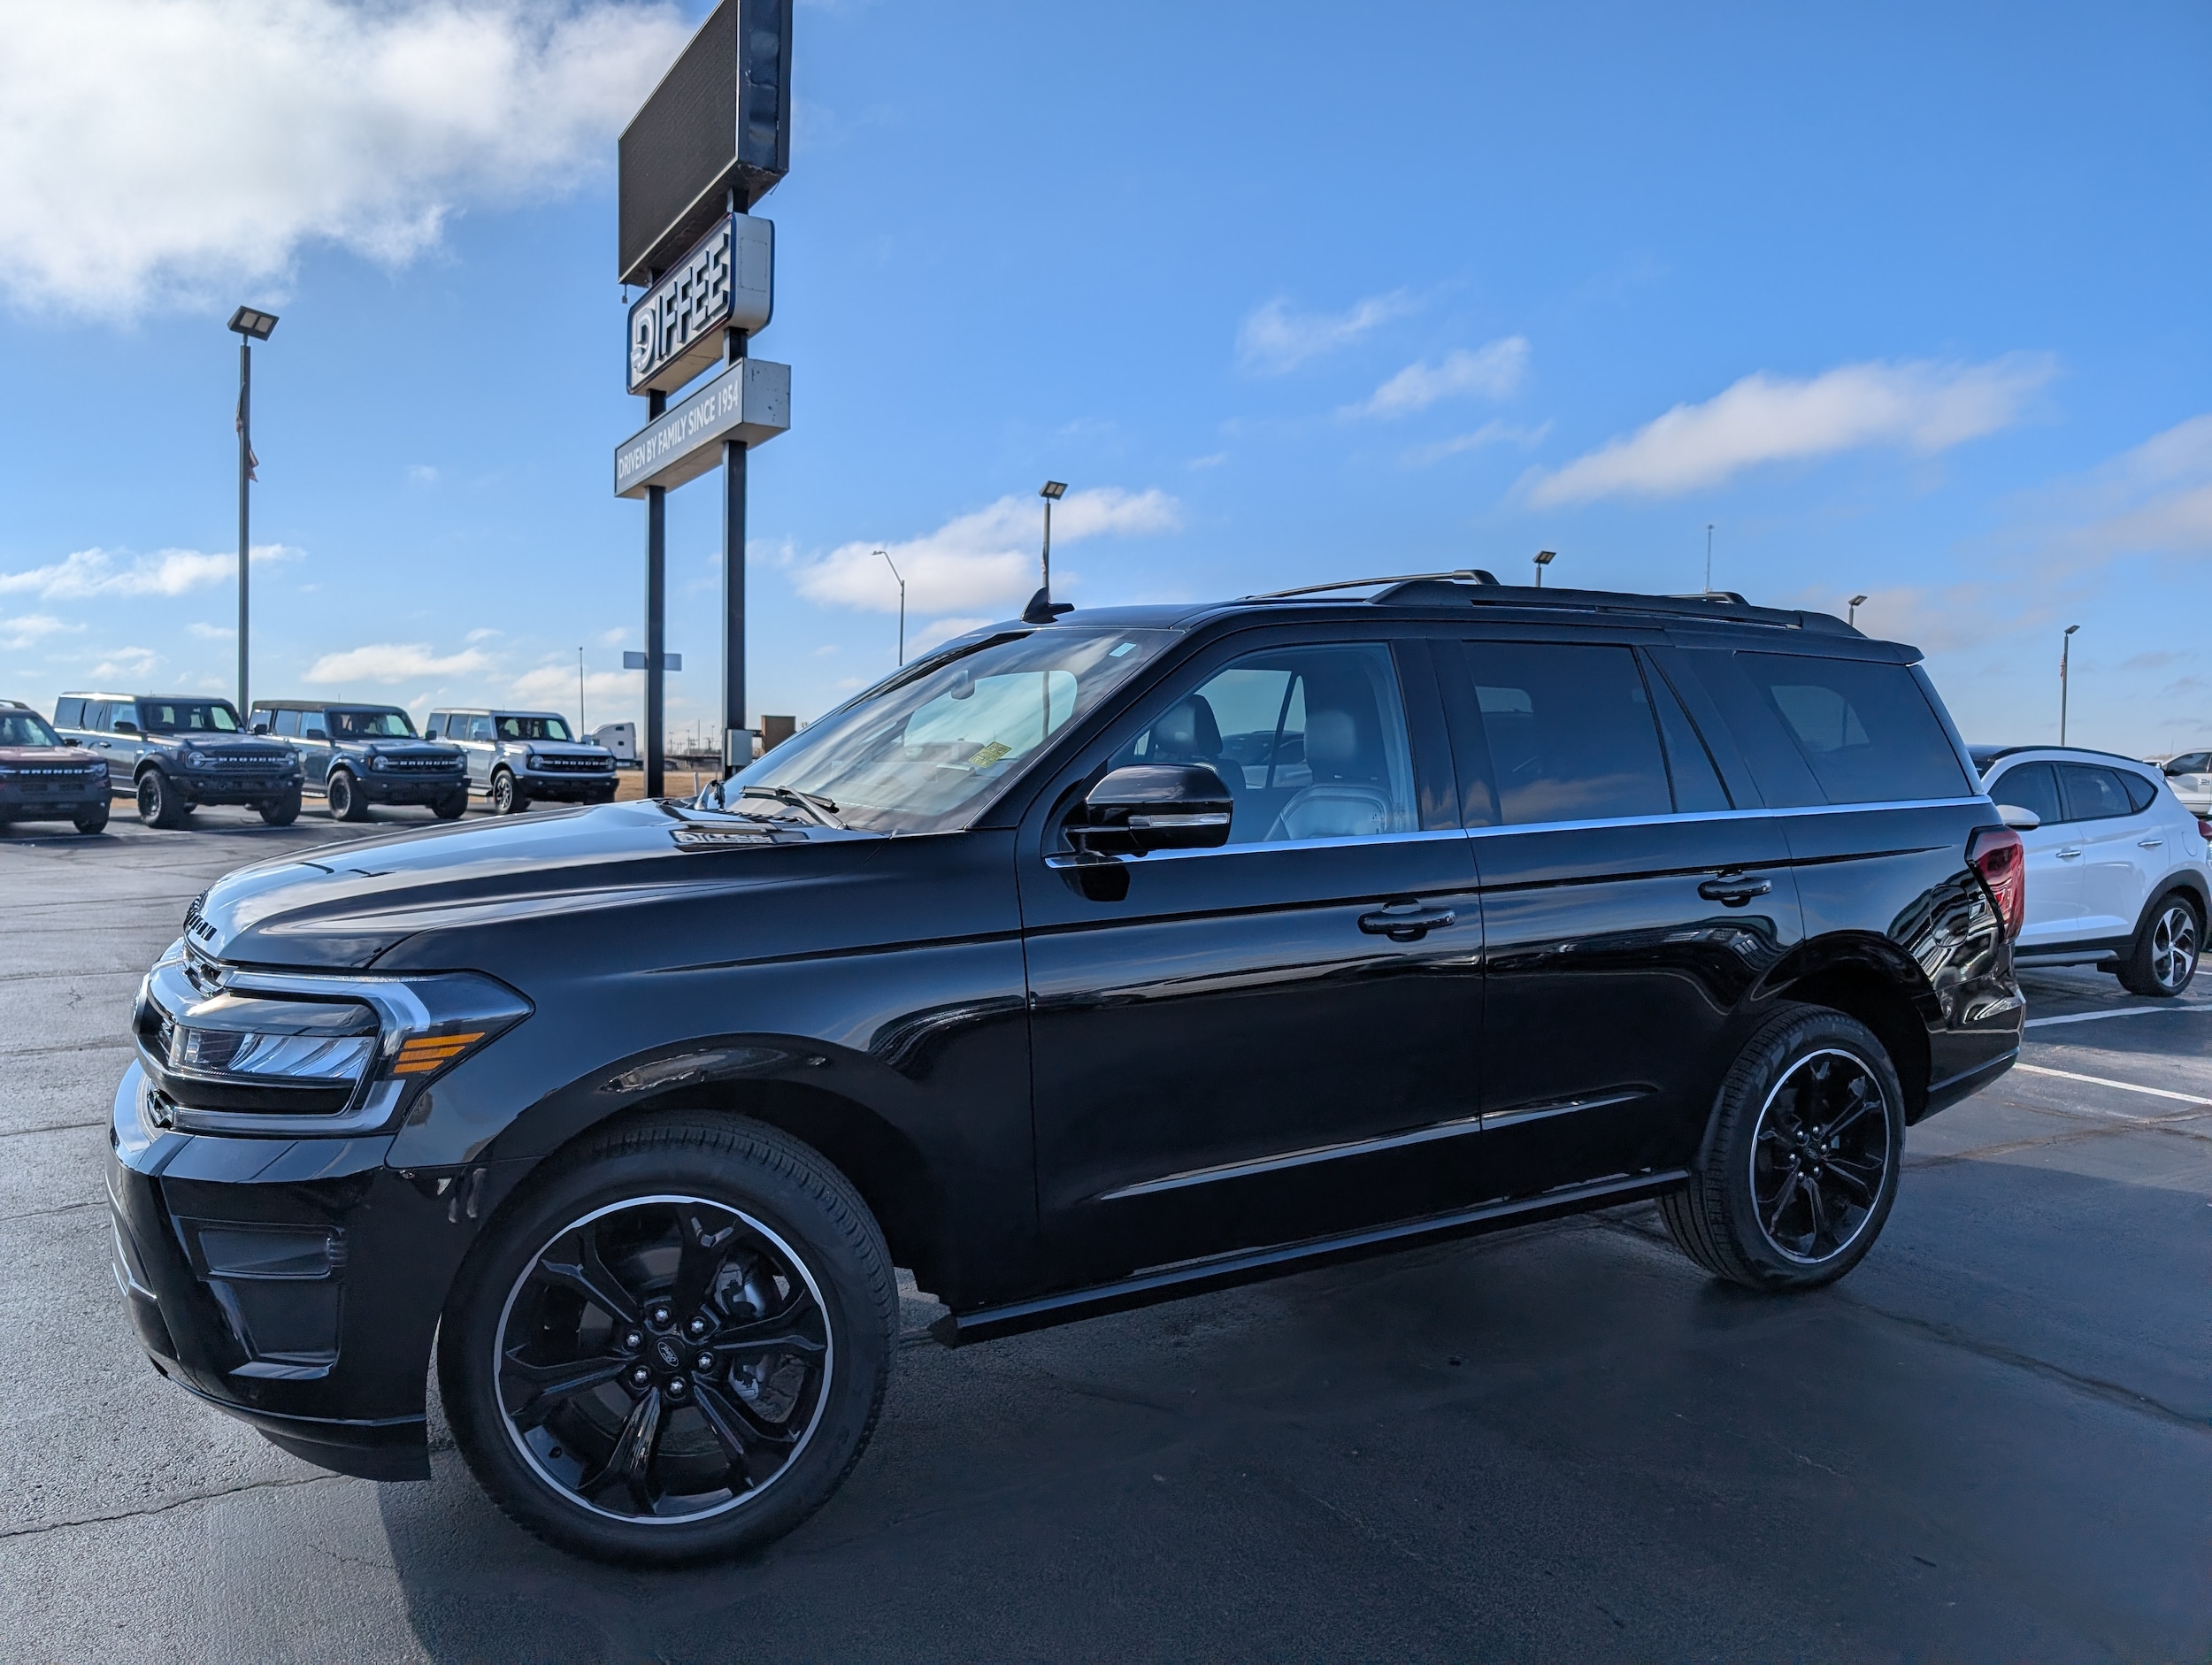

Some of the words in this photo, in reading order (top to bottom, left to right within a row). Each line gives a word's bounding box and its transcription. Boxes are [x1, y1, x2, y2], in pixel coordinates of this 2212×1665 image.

[630, 232, 729, 374] DIFFEE
[618, 443, 646, 480] DRIVEN
[646, 434, 657, 463] BY
[657, 414, 687, 456] FAMILY
[687, 395, 716, 435] SINCE
[718, 380, 739, 417] 1954
